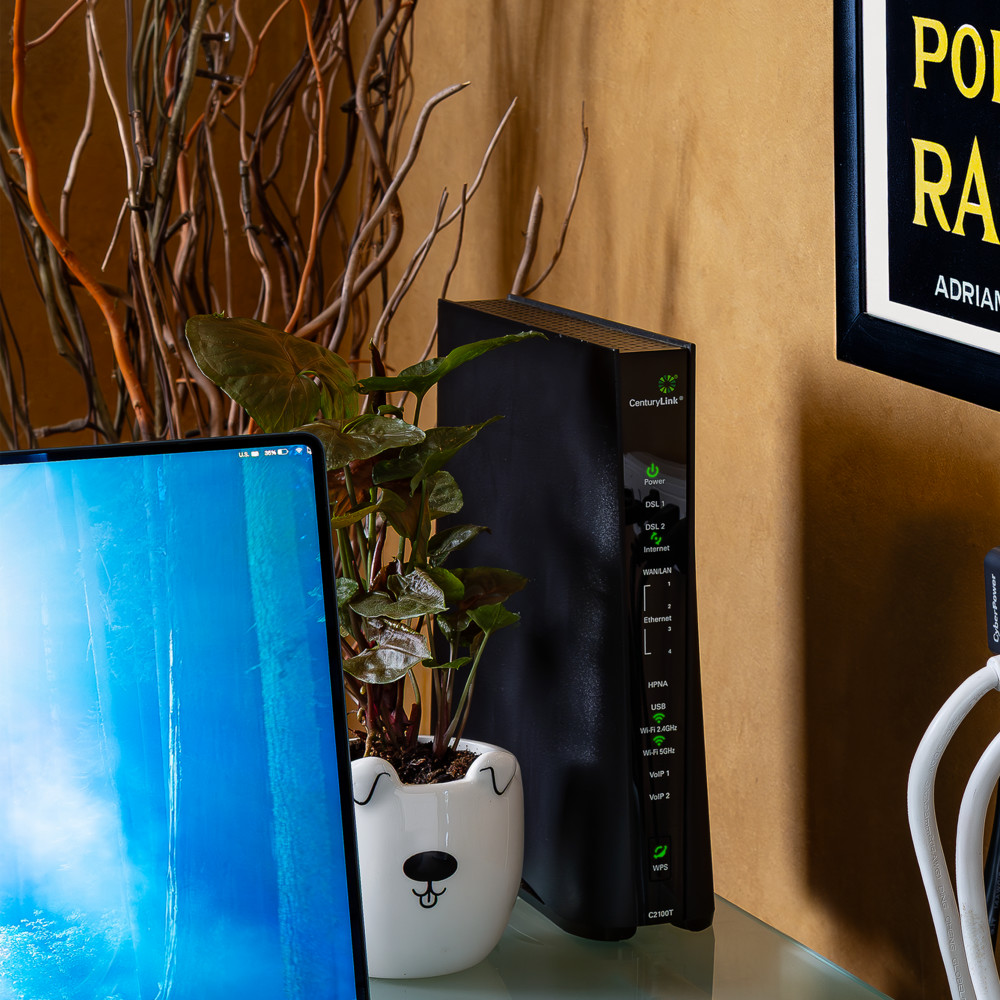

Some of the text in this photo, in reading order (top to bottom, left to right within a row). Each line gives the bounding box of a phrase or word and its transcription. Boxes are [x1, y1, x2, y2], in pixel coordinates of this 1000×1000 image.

[643, 478, 666, 486] Power
[645, 500, 660, 508] DSL
[645, 522, 666, 531] DSL 2
[643, 544, 671, 553] Internet
[642, 566, 673, 576] WAN/LAN
[991, 573, 1000, 643] CyberPower
[643, 615, 673, 624] Ethernet
[647, 680, 669, 689] HPNA
[650, 702, 667, 711] USB
[639, 724, 678, 735] Wi-Fi 2.4GHz
[642, 746, 676, 757] Wi-Fi 5GHz
[649, 770, 665, 779] VoIP
[648, 792, 670, 801] VoIP 2
[652, 863, 669, 872] WPS
[648, 909, 674, 919] C2100T
